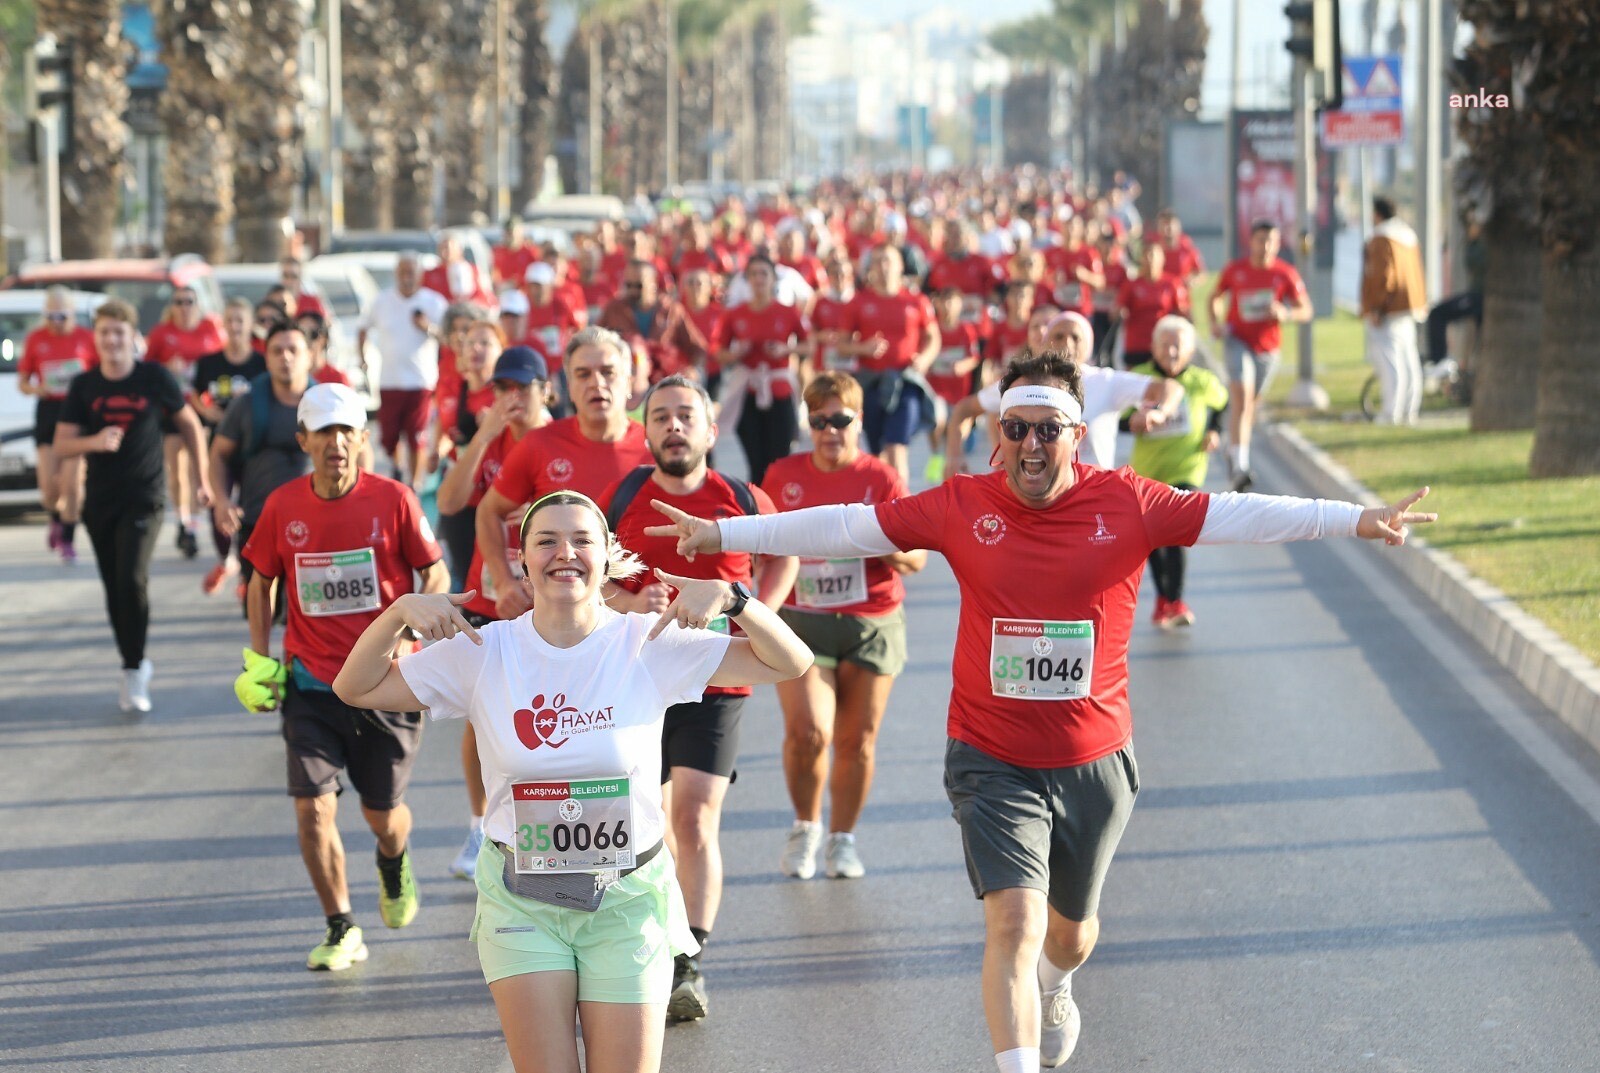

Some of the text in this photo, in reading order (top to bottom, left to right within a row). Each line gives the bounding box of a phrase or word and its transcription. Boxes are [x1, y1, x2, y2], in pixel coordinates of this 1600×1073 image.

[301, 577, 374, 602] 350885
[1003, 626, 1042, 634] KARŞIYAKA
[994, 656, 1083, 681] 351046
[561, 707, 614, 728] HAYAT
[571, 726, 591, 735] Güzel
[593, 722, 616, 732] Hediye
[523, 784, 619, 797] KARŞIYAKA BELEDİYESİ
[518, 820, 629, 852] 350066
